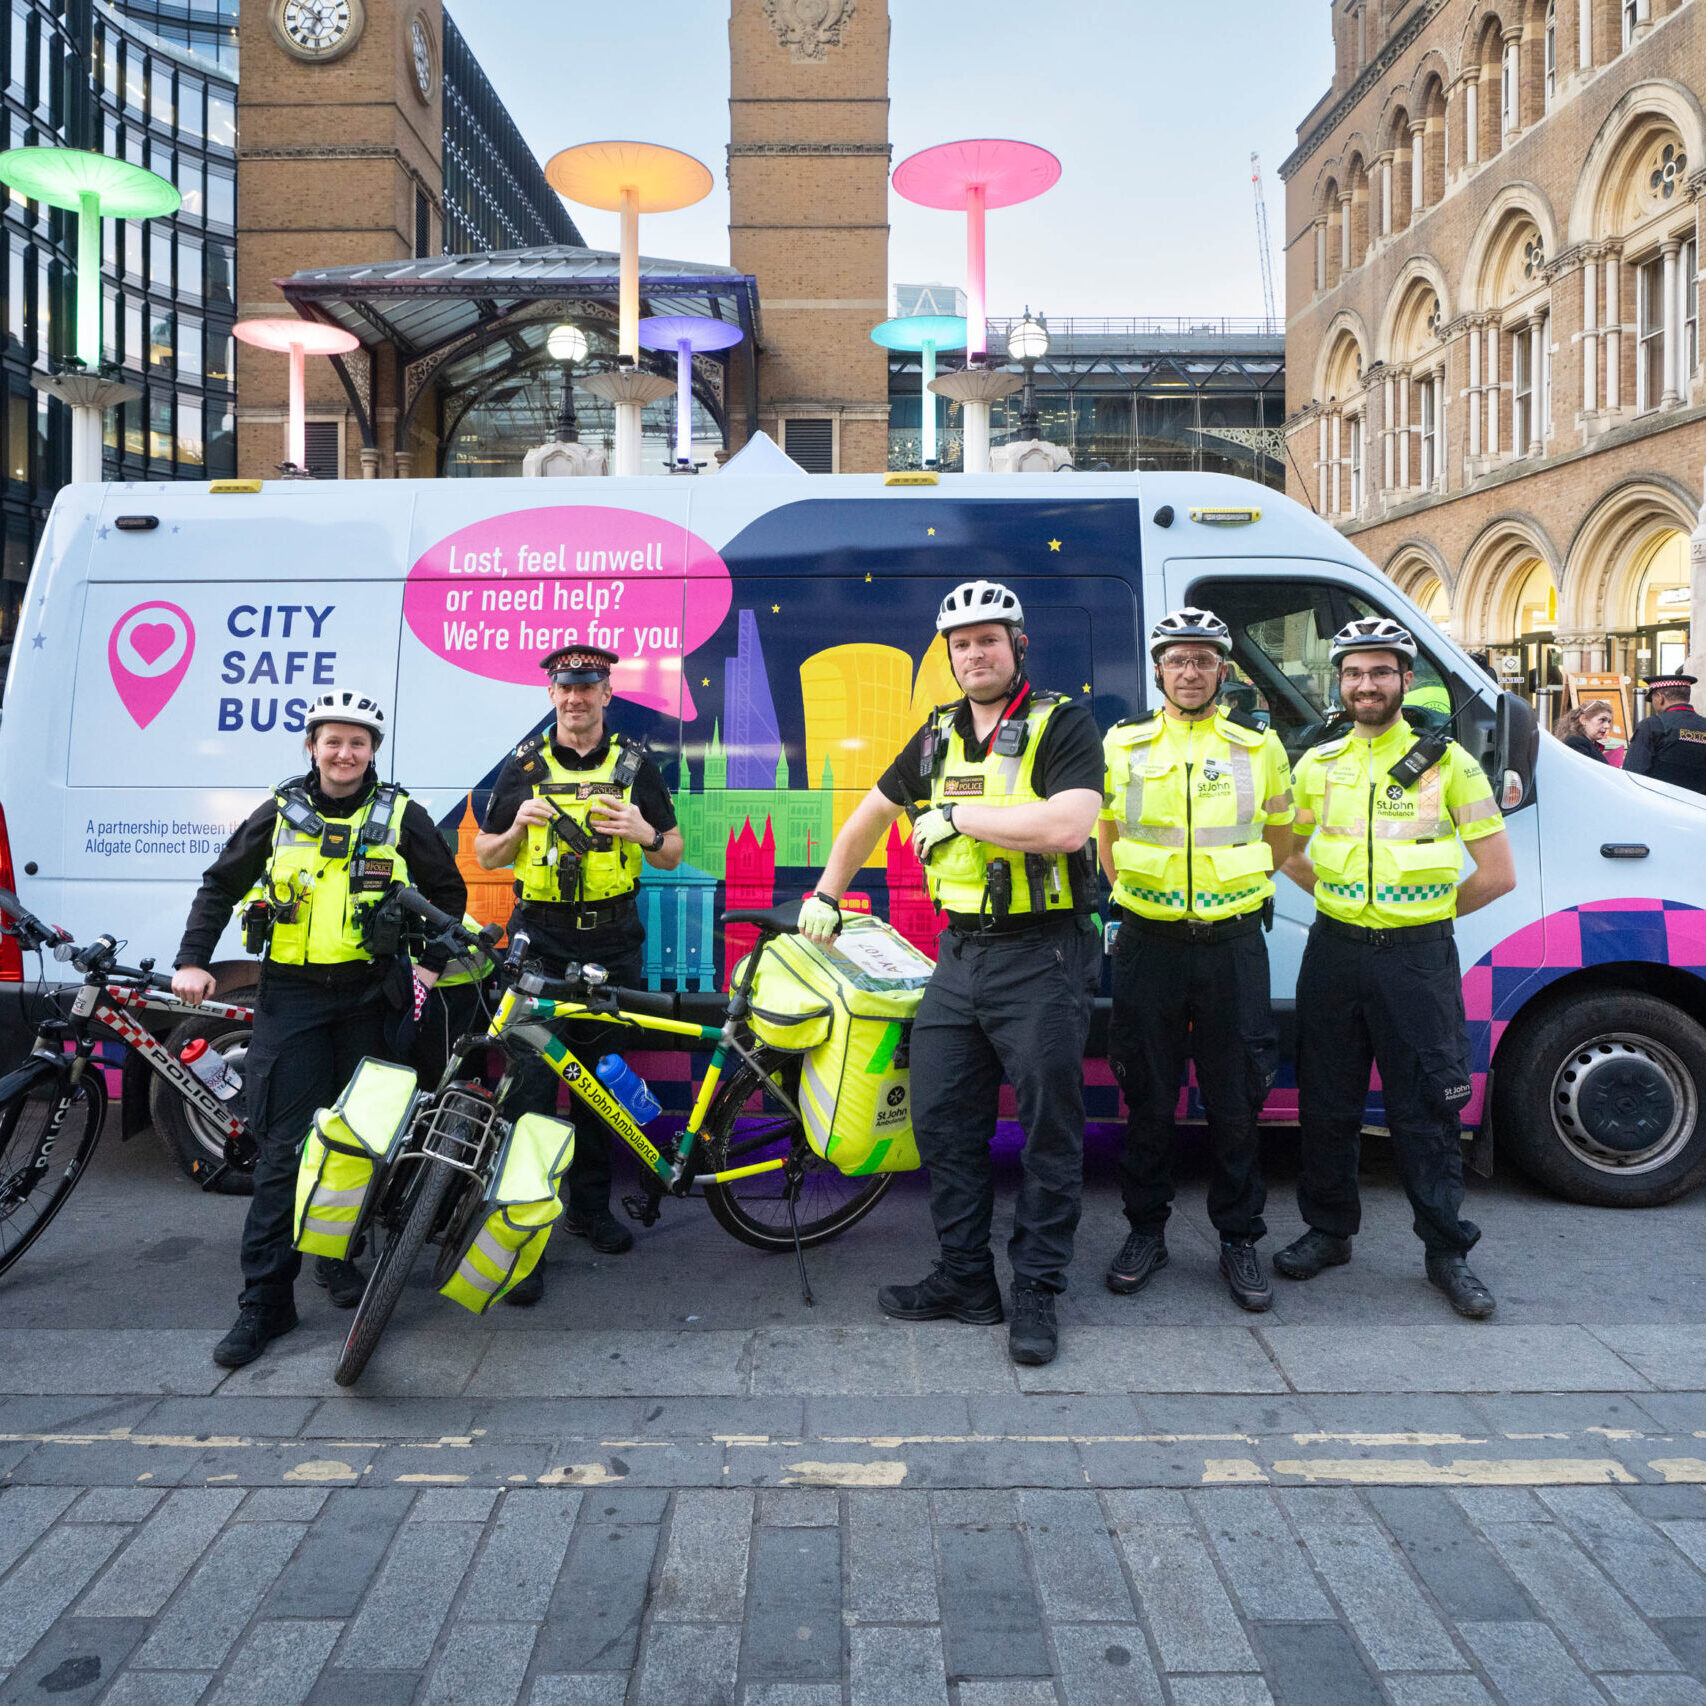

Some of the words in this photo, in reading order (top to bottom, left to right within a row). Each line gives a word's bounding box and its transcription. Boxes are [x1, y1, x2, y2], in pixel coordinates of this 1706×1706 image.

[449, 546, 508, 577] Lost,
[517, 544, 566, 573] feel
[576, 543, 663, 572] unwell
[446, 590, 473, 611] or
[482, 582, 544, 611] need
[553, 581, 624, 617] help?
[227, 605, 336, 638] CITY
[443, 621, 509, 650] We're
[520, 620, 578, 650] here
[587, 620, 624, 650] for
[221, 650, 336, 685] SAFE
[218, 698, 308, 732] BUS
[1197, 783, 1206, 792] St
[1207, 782, 1231, 792] John
[1376, 800, 1389, 810] St
[1389, 801, 1414, 810] John
[86, 820, 94, 834] A
[98, 820, 168, 837] partnership
[172, 820, 225, 834] between
[85, 839, 131, 856] Aldgate
[135, 840, 185, 854] Connect
[189, 840, 210, 854] BID
[167, 998, 223, 1014] OLICE
[151, 1049, 229, 1124] POLICE
[1444, 1088, 1453, 1096] St
[1453, 1084, 1470, 1094] John
[578, 1077, 592, 1093] St
[588, 1089, 612, 1115] John
[610, 1111, 658, 1163] Ambulance
[876, 1111, 886, 1121] St
[887, 1108, 908, 1119] John
